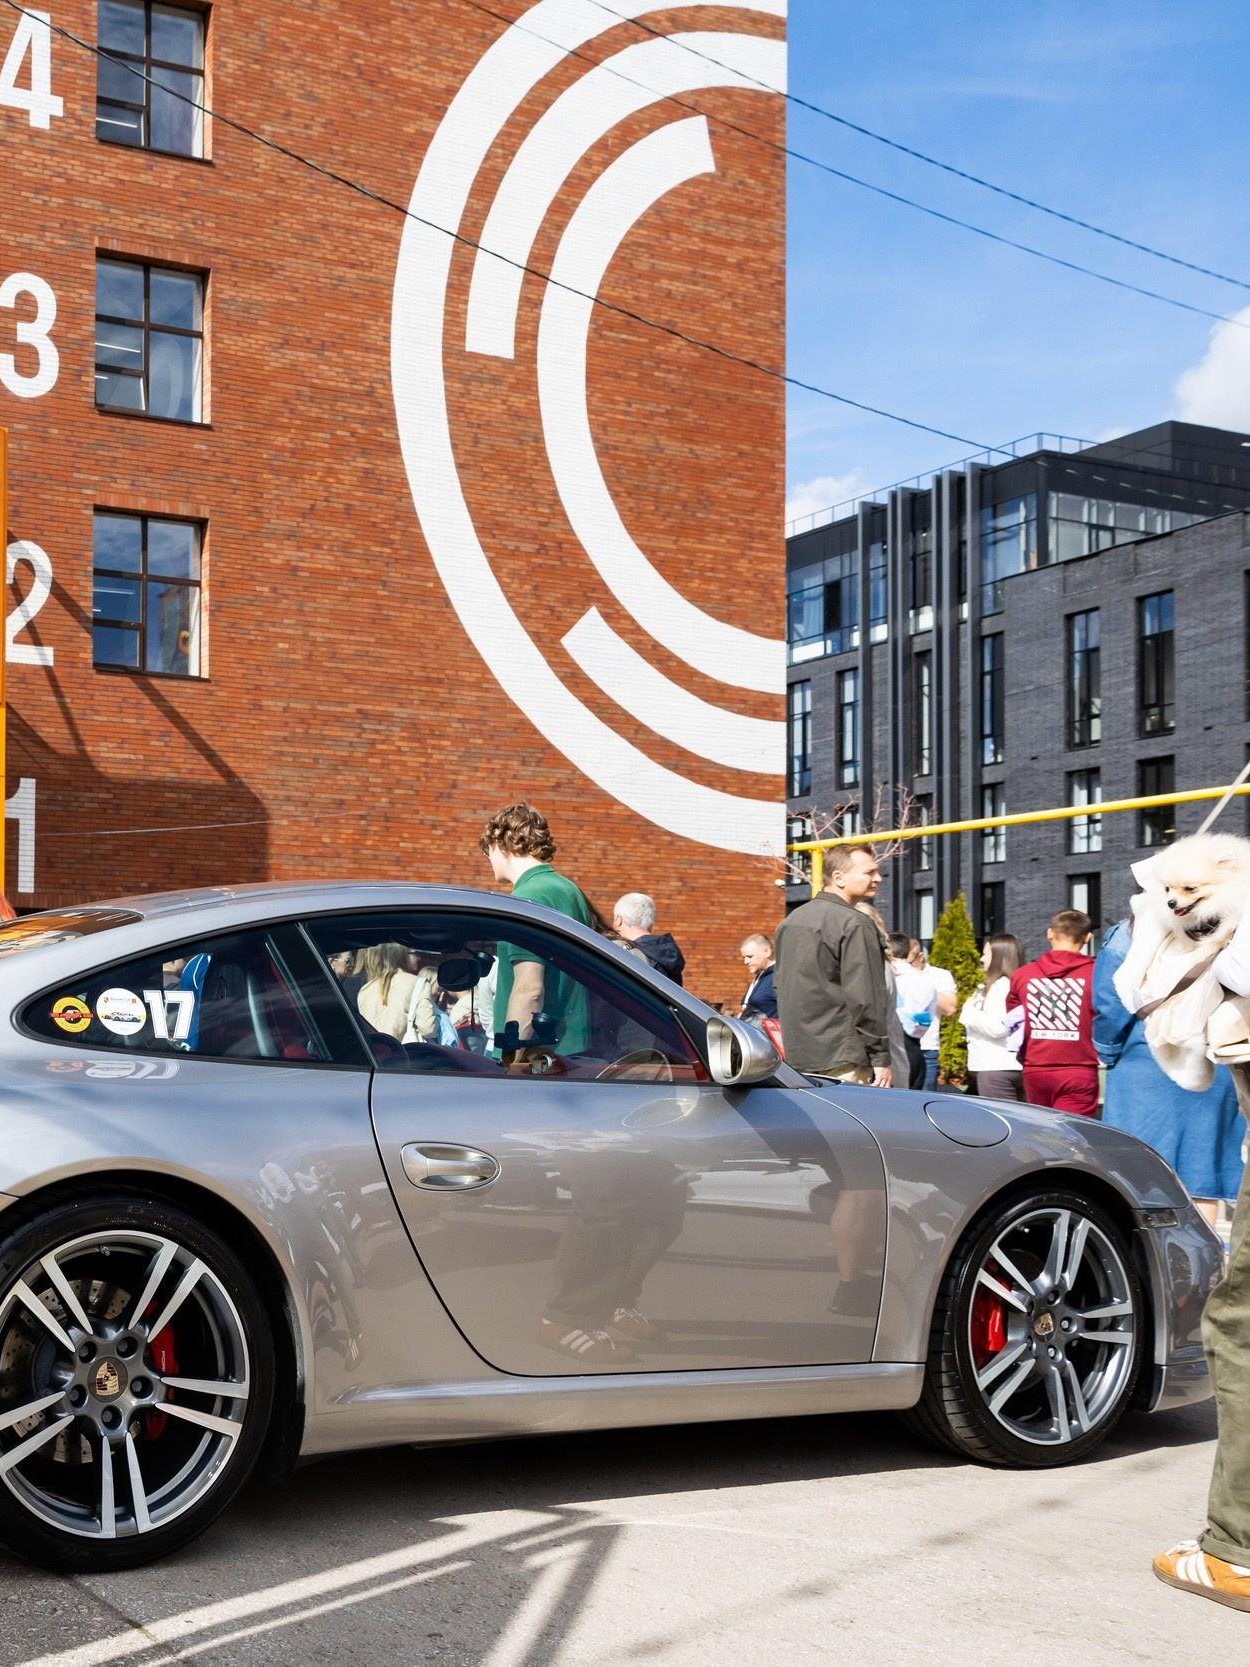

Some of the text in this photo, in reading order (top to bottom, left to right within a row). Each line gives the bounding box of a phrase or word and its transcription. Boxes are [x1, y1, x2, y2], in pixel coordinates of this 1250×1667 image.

[5, 540, 53, 667] 2
[4, 777, 36, 893] 1
[142, 989, 195, 1040] 17
